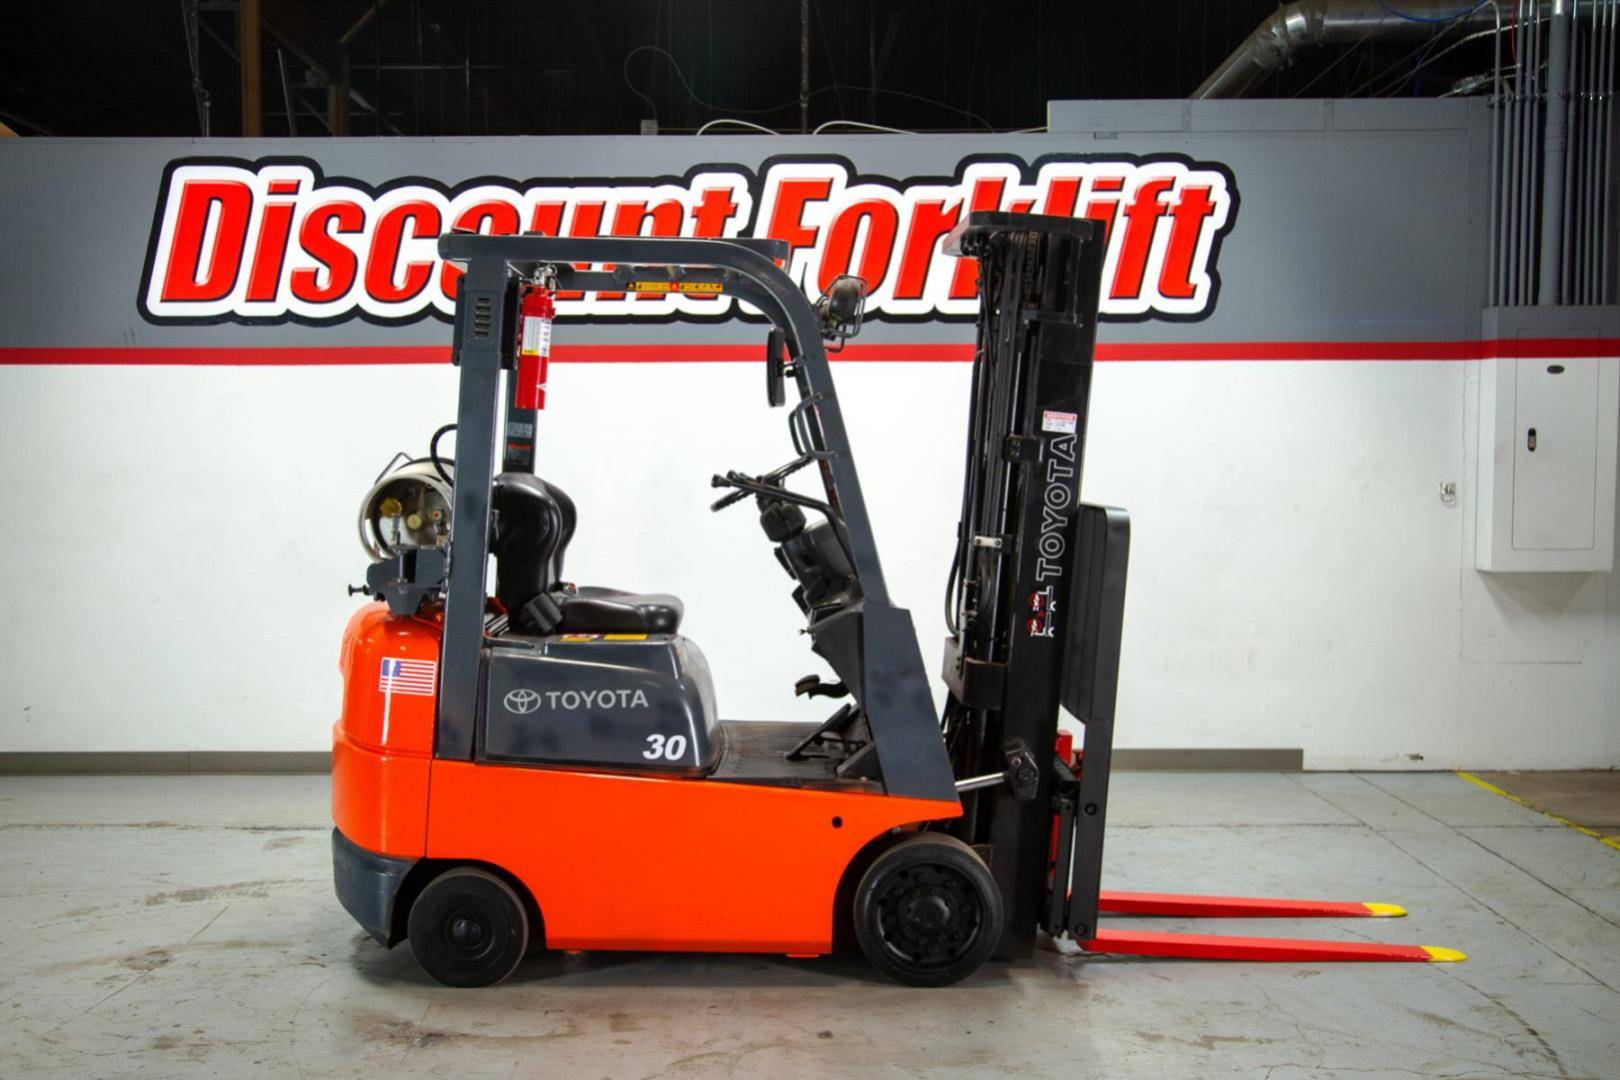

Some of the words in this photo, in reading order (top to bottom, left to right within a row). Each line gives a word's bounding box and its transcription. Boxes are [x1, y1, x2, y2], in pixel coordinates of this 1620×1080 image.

[1035, 433, 1077, 582] TOYOTA
[546, 689, 649, 711] TOYOTA
[642, 733, 687, 761] 30
